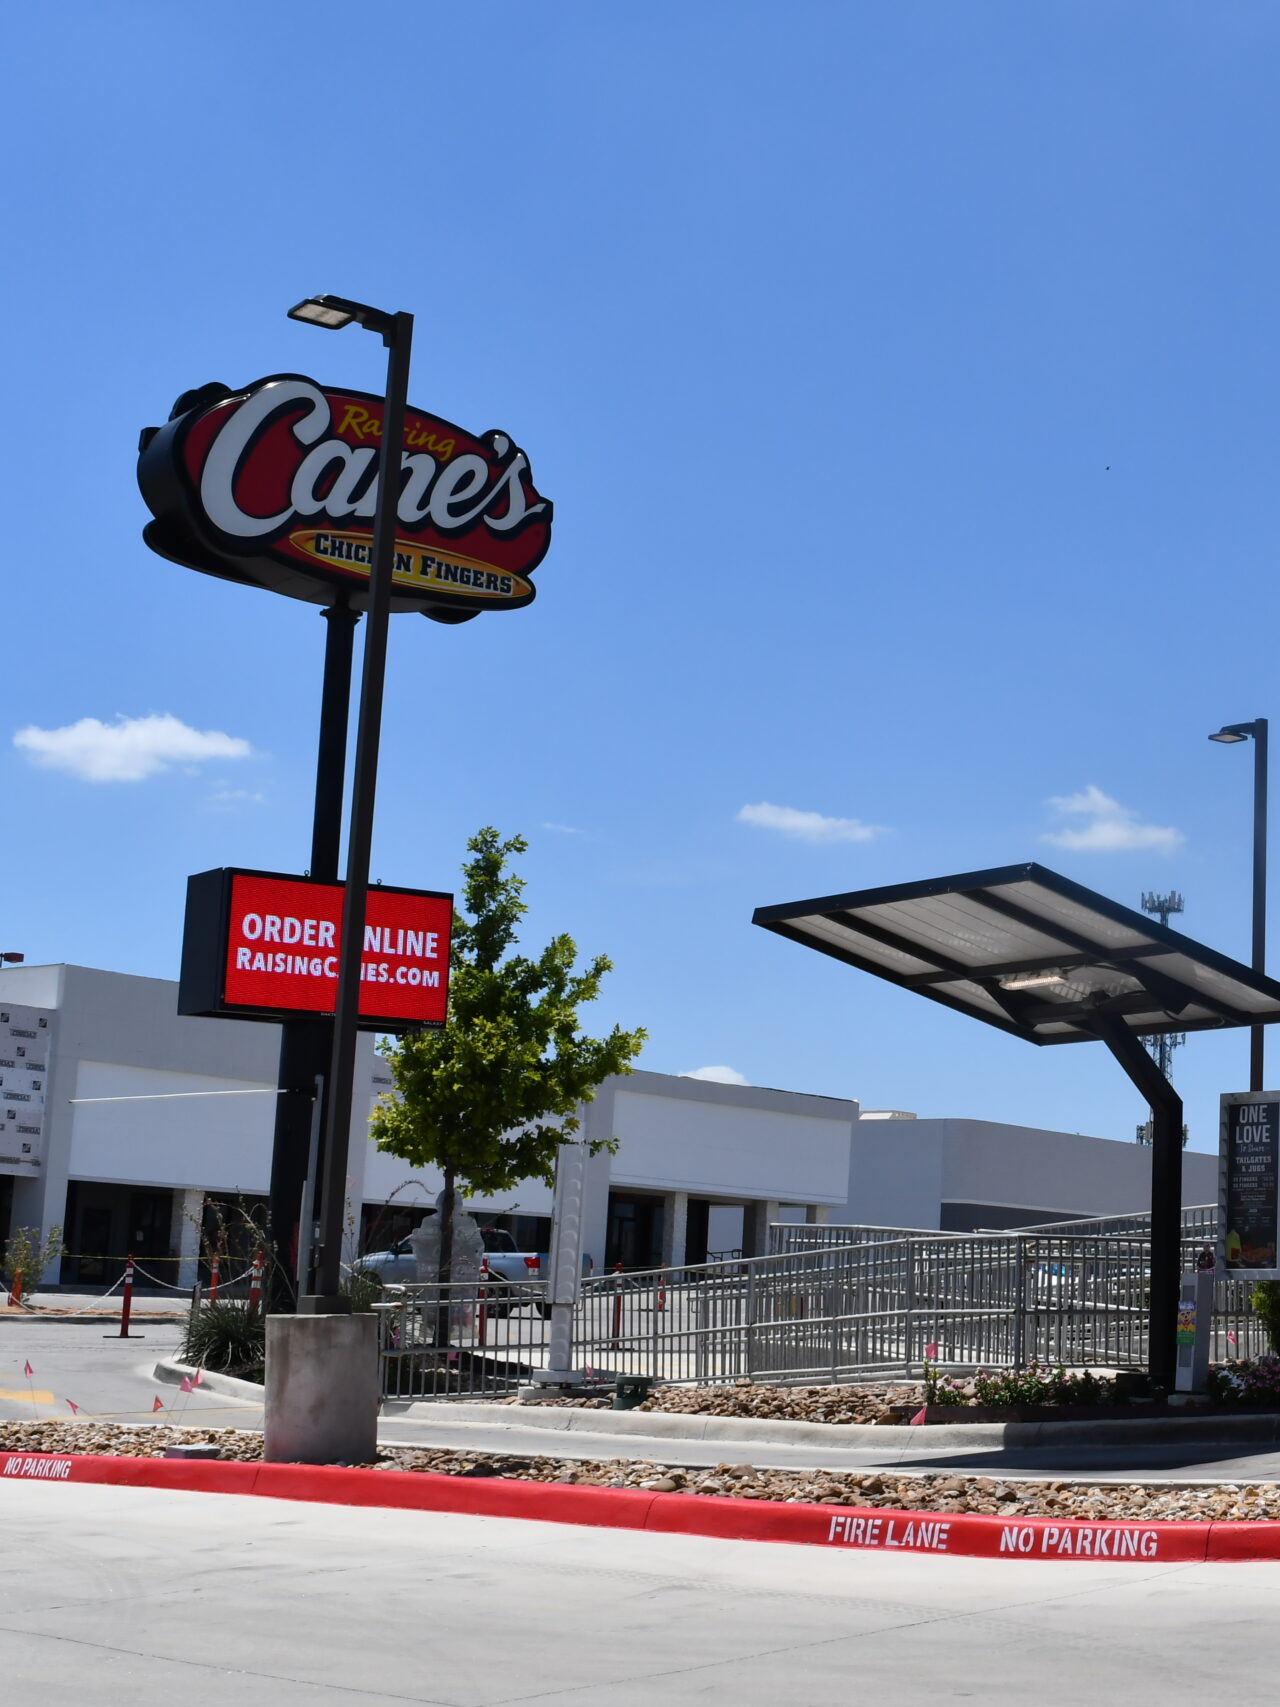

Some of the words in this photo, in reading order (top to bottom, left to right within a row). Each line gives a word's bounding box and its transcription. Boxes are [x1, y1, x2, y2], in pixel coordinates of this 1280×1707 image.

[338, 405, 455, 461] Raing
[201, 380, 546, 537] Cane's
[315, 533, 412, 572] CHICN
[420, 554, 513, 594] FINGERS
[242, 913, 335, 948] ORDER
[363, 925, 439, 958] NLINE
[1240, 1105, 1267, 1123] ONE
[1235, 1125, 1271, 1144] LOVE
[1235, 1156, 1272, 1165] TAILGATES
[1248, 1165, 1266, 1173] JUGS
[3, 1457, 22, 1475] NO
[20, 1458, 72, 1478] PARKING
[828, 1515, 882, 1545] FIRE
[884, 1519, 950, 1550] LANE
[1000, 1526, 1035, 1553] NO
[1041, 1527, 1158, 1557] PARKING
